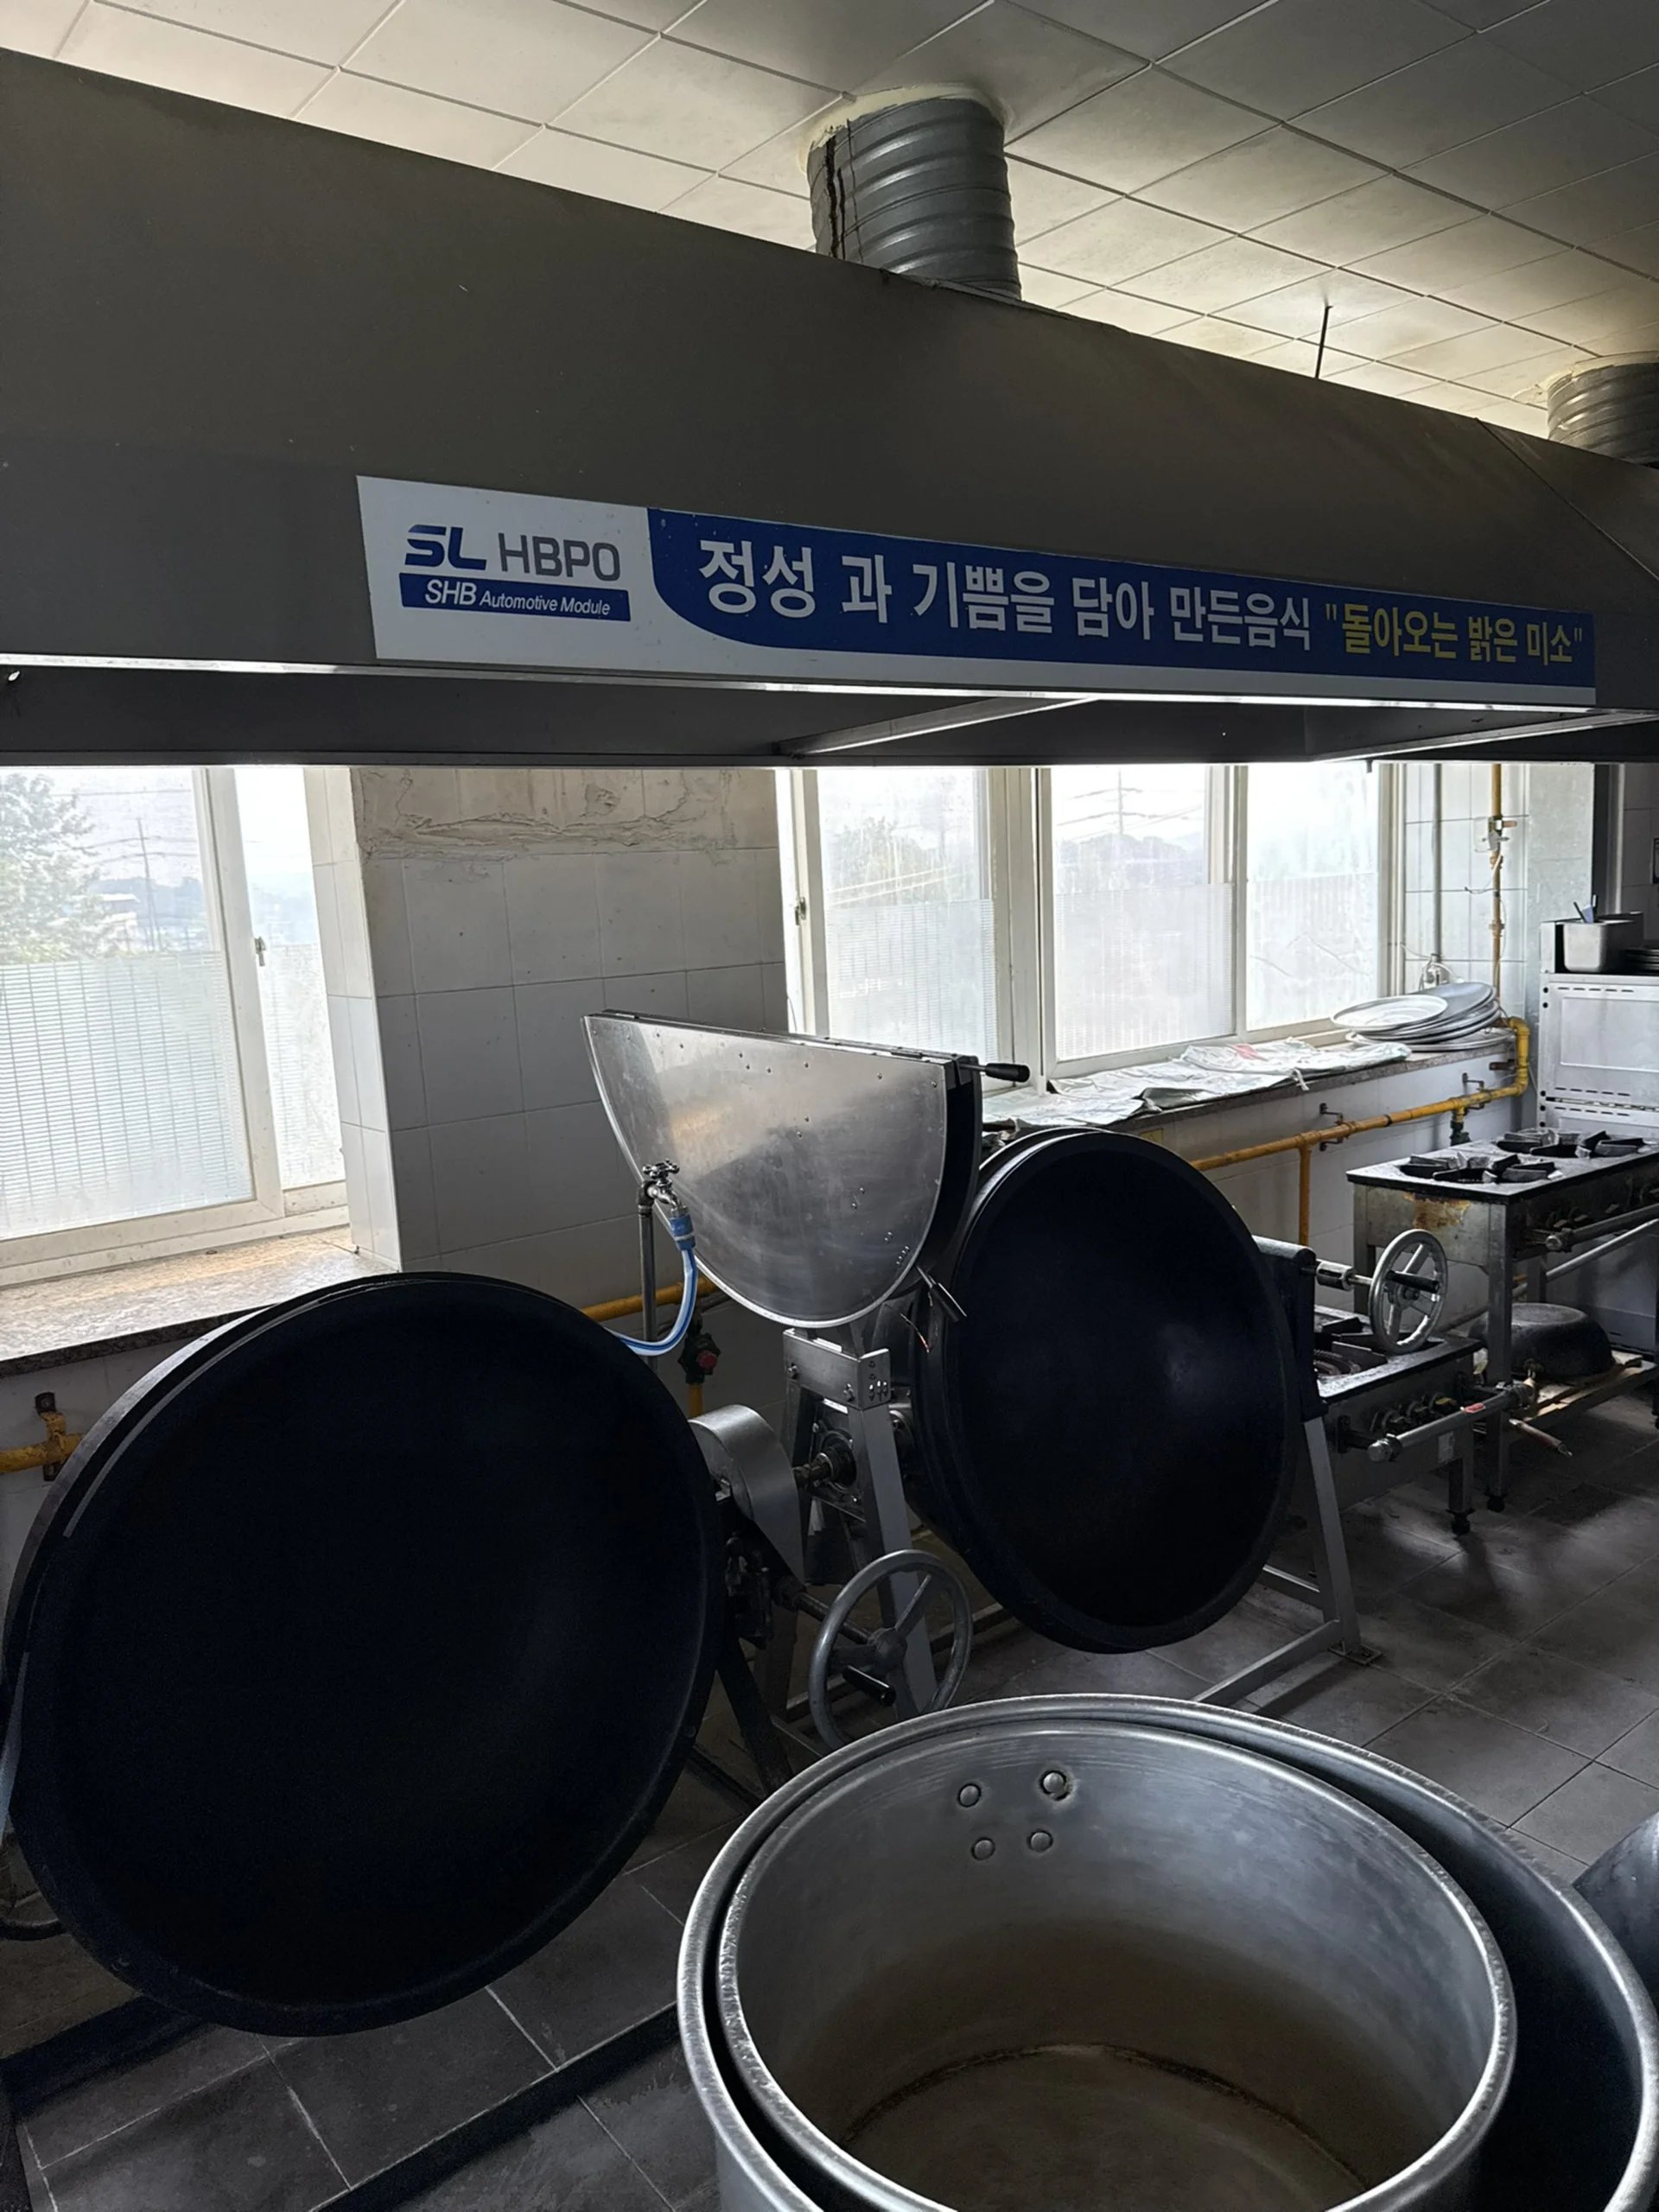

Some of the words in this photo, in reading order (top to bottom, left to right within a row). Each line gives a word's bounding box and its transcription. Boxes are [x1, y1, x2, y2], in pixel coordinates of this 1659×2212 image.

[404, 524, 487, 570] SL
[498, 532, 620, 582] HBPO
[425, 581, 477, 606] SHB
[480, 592, 558, 612] Automotive
[560, 596, 611, 616] Module
[699, 538, 817, 619] 정성
[841, 554, 893, 624] 과
[912, 562, 1055, 634] 기쁨을
[1072, 576, 1154, 640] 담아
[1170, 586, 1311, 651] 만든음식
[1325, 602, 1459, 659] "돌아오는
[1469, 615, 1517, 664] 밝은
[1527, 621, 1583, 666] 미소"
